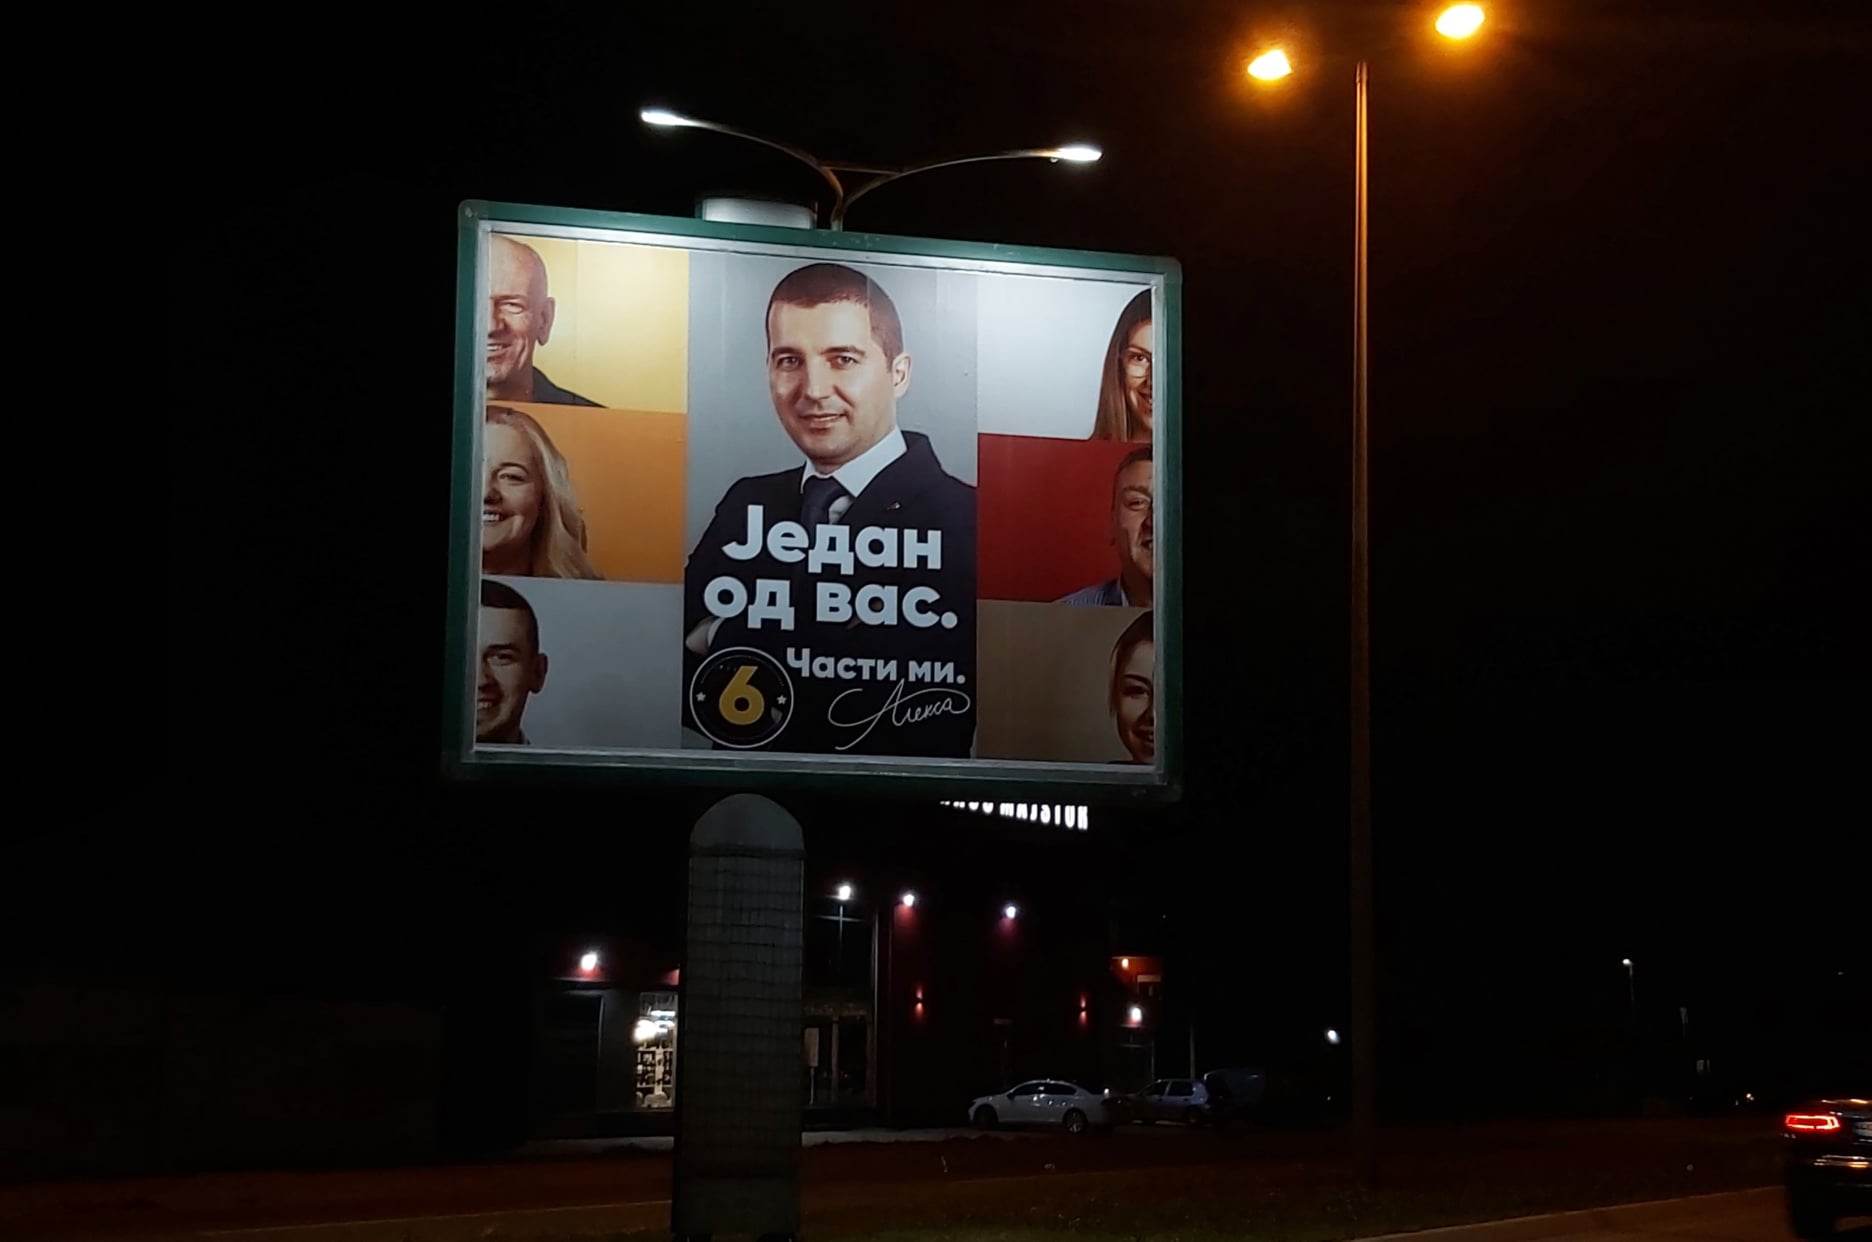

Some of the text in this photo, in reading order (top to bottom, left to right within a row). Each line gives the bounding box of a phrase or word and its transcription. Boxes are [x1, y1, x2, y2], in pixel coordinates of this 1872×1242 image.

[722, 504, 942, 575] Један
[704, 576, 958, 631] од вас.
[786, 647, 966, 684] Части ми.
[719, 665, 765, 725] 6
